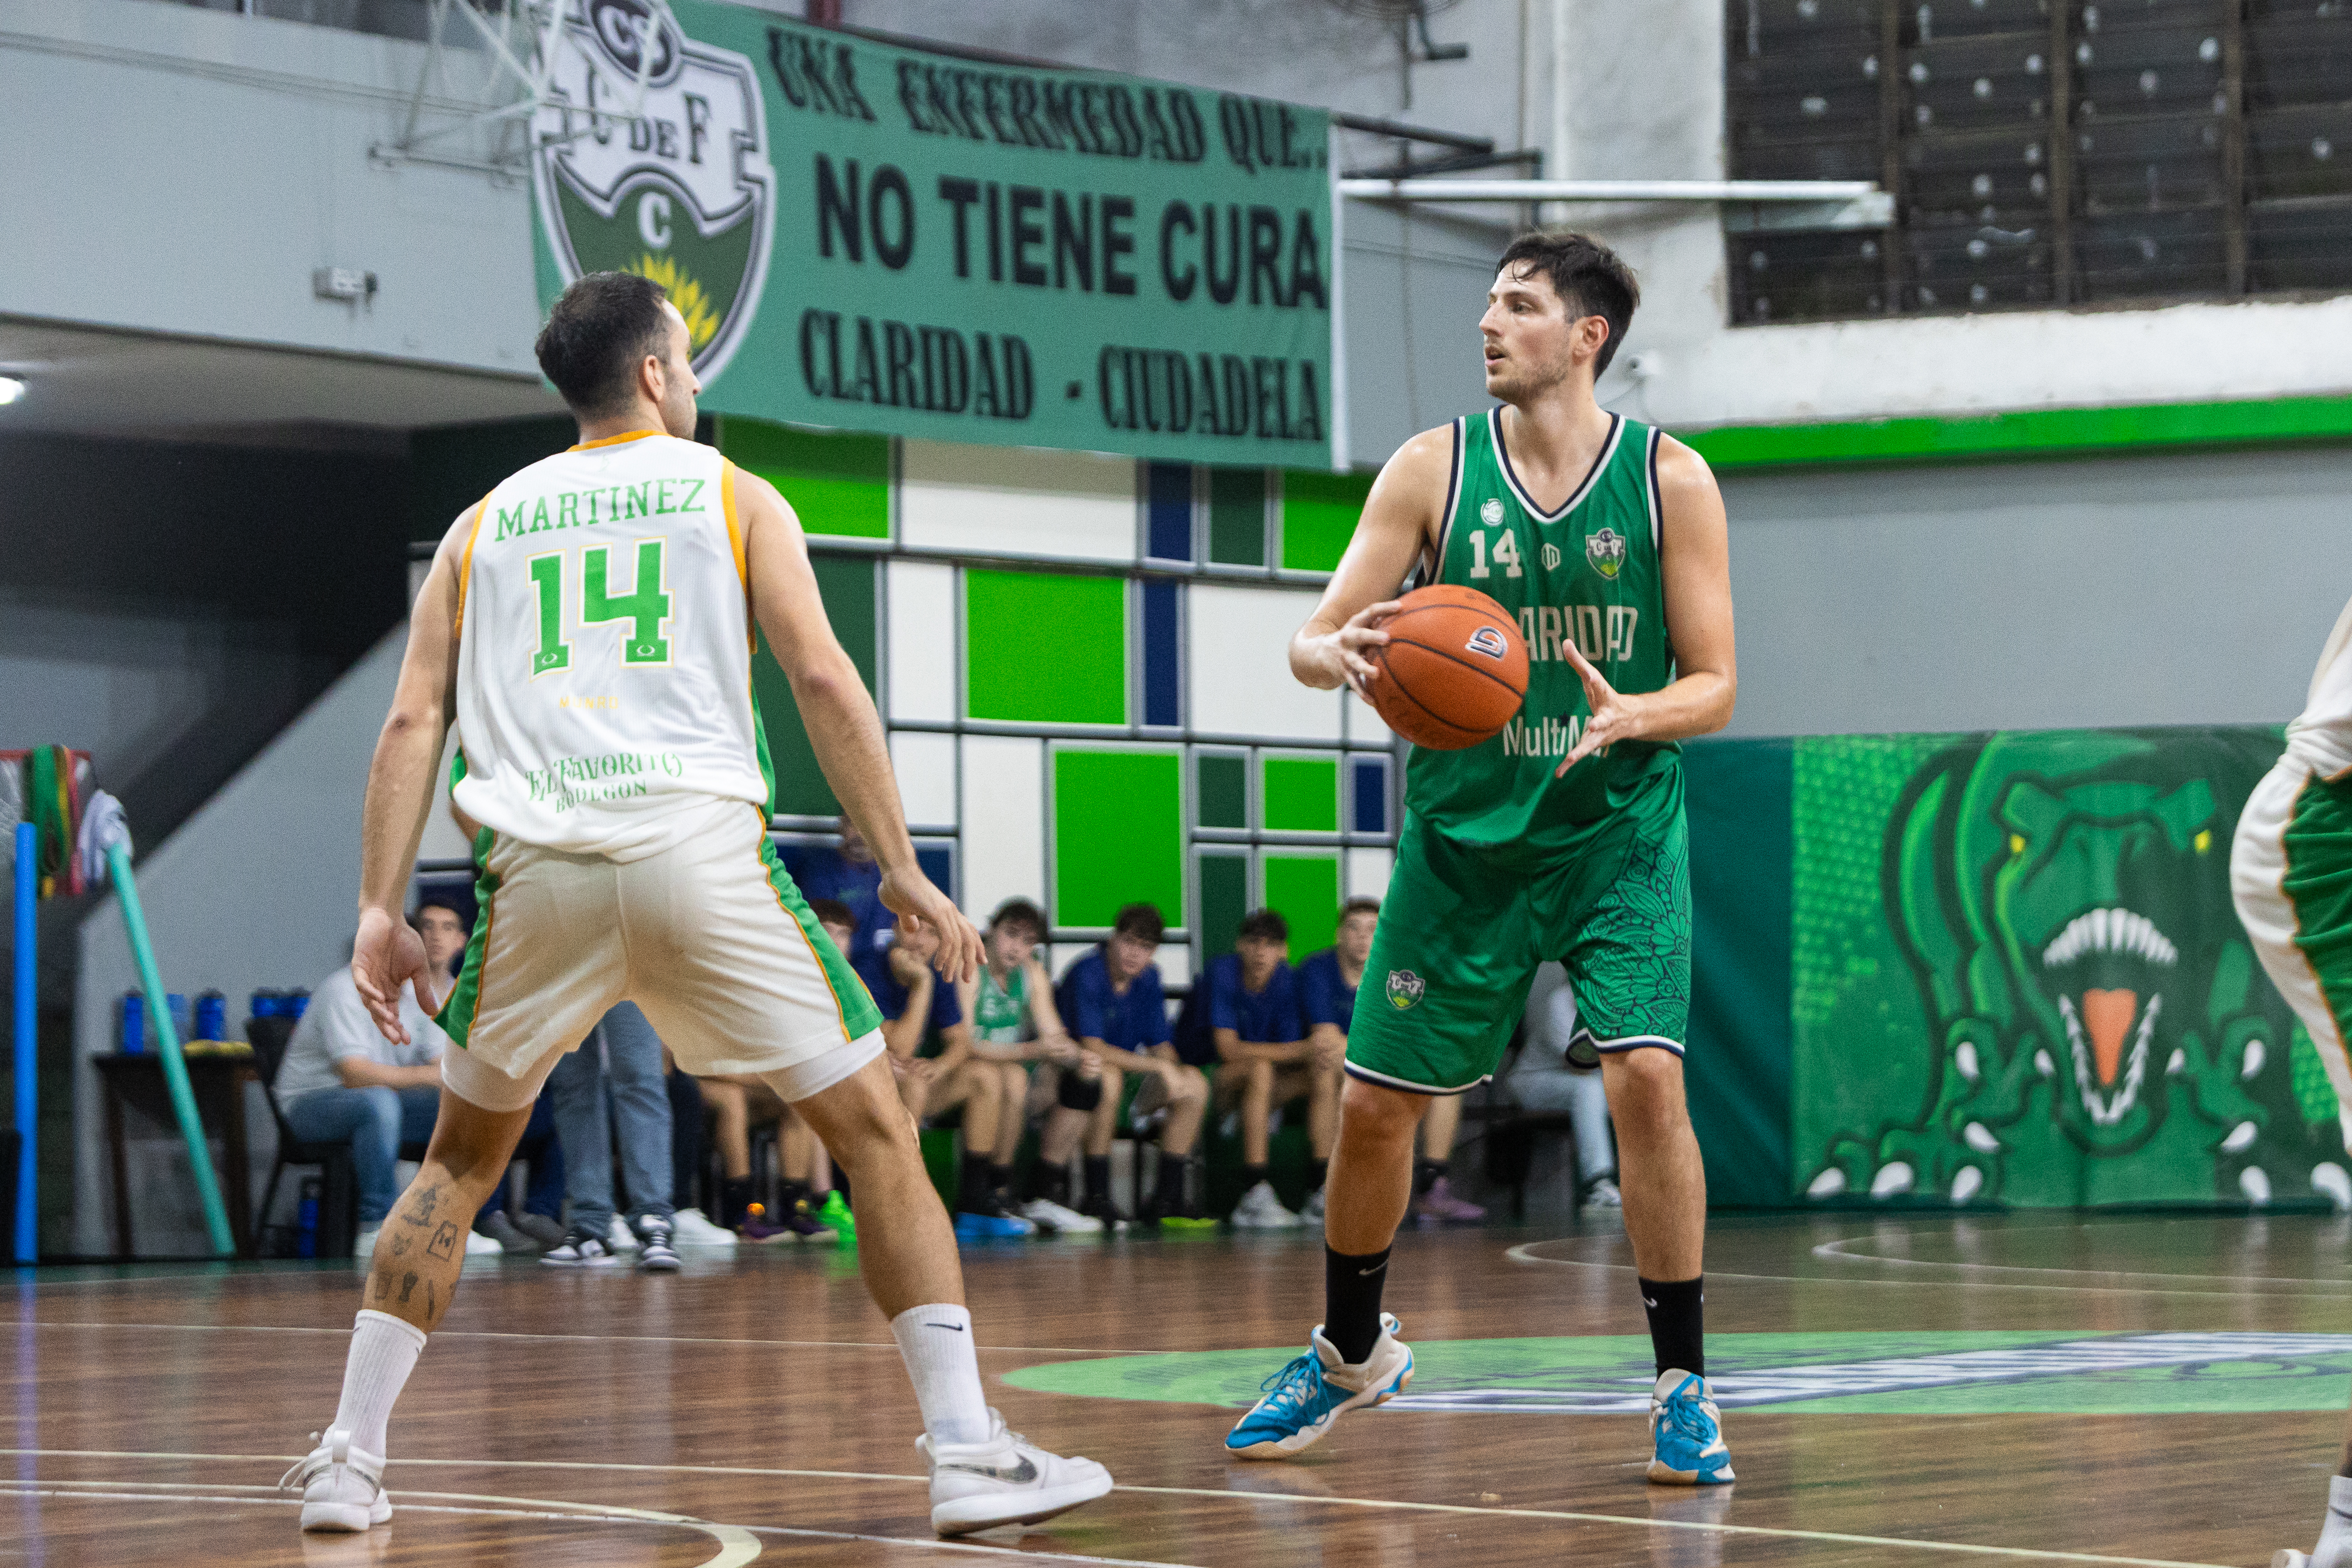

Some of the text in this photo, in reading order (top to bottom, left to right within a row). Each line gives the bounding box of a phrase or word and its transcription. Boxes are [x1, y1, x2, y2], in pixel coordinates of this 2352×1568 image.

[766, 26, 878, 123] UNA
[897, 59, 1206, 163] ENFERMEDAD
[629, 115, 679, 160] DE
[638, 190, 672, 249] C
[815, 153, 1329, 309] NO TIENE CURA
[799, 307, 1035, 421] CLARIDAD
[1099, 344, 1325, 442] CIUDADELA
[494, 478, 706, 542] MARTINEZ
[1469, 528, 1523, 579] 14
[526, 537, 675, 682] 14
[1518, 605, 1638, 662] ARIDAD
[559, 696, 618, 709] MUNRO
[553, 751, 682, 793] FAVORITO
[556, 779, 647, 813] BODEGON
